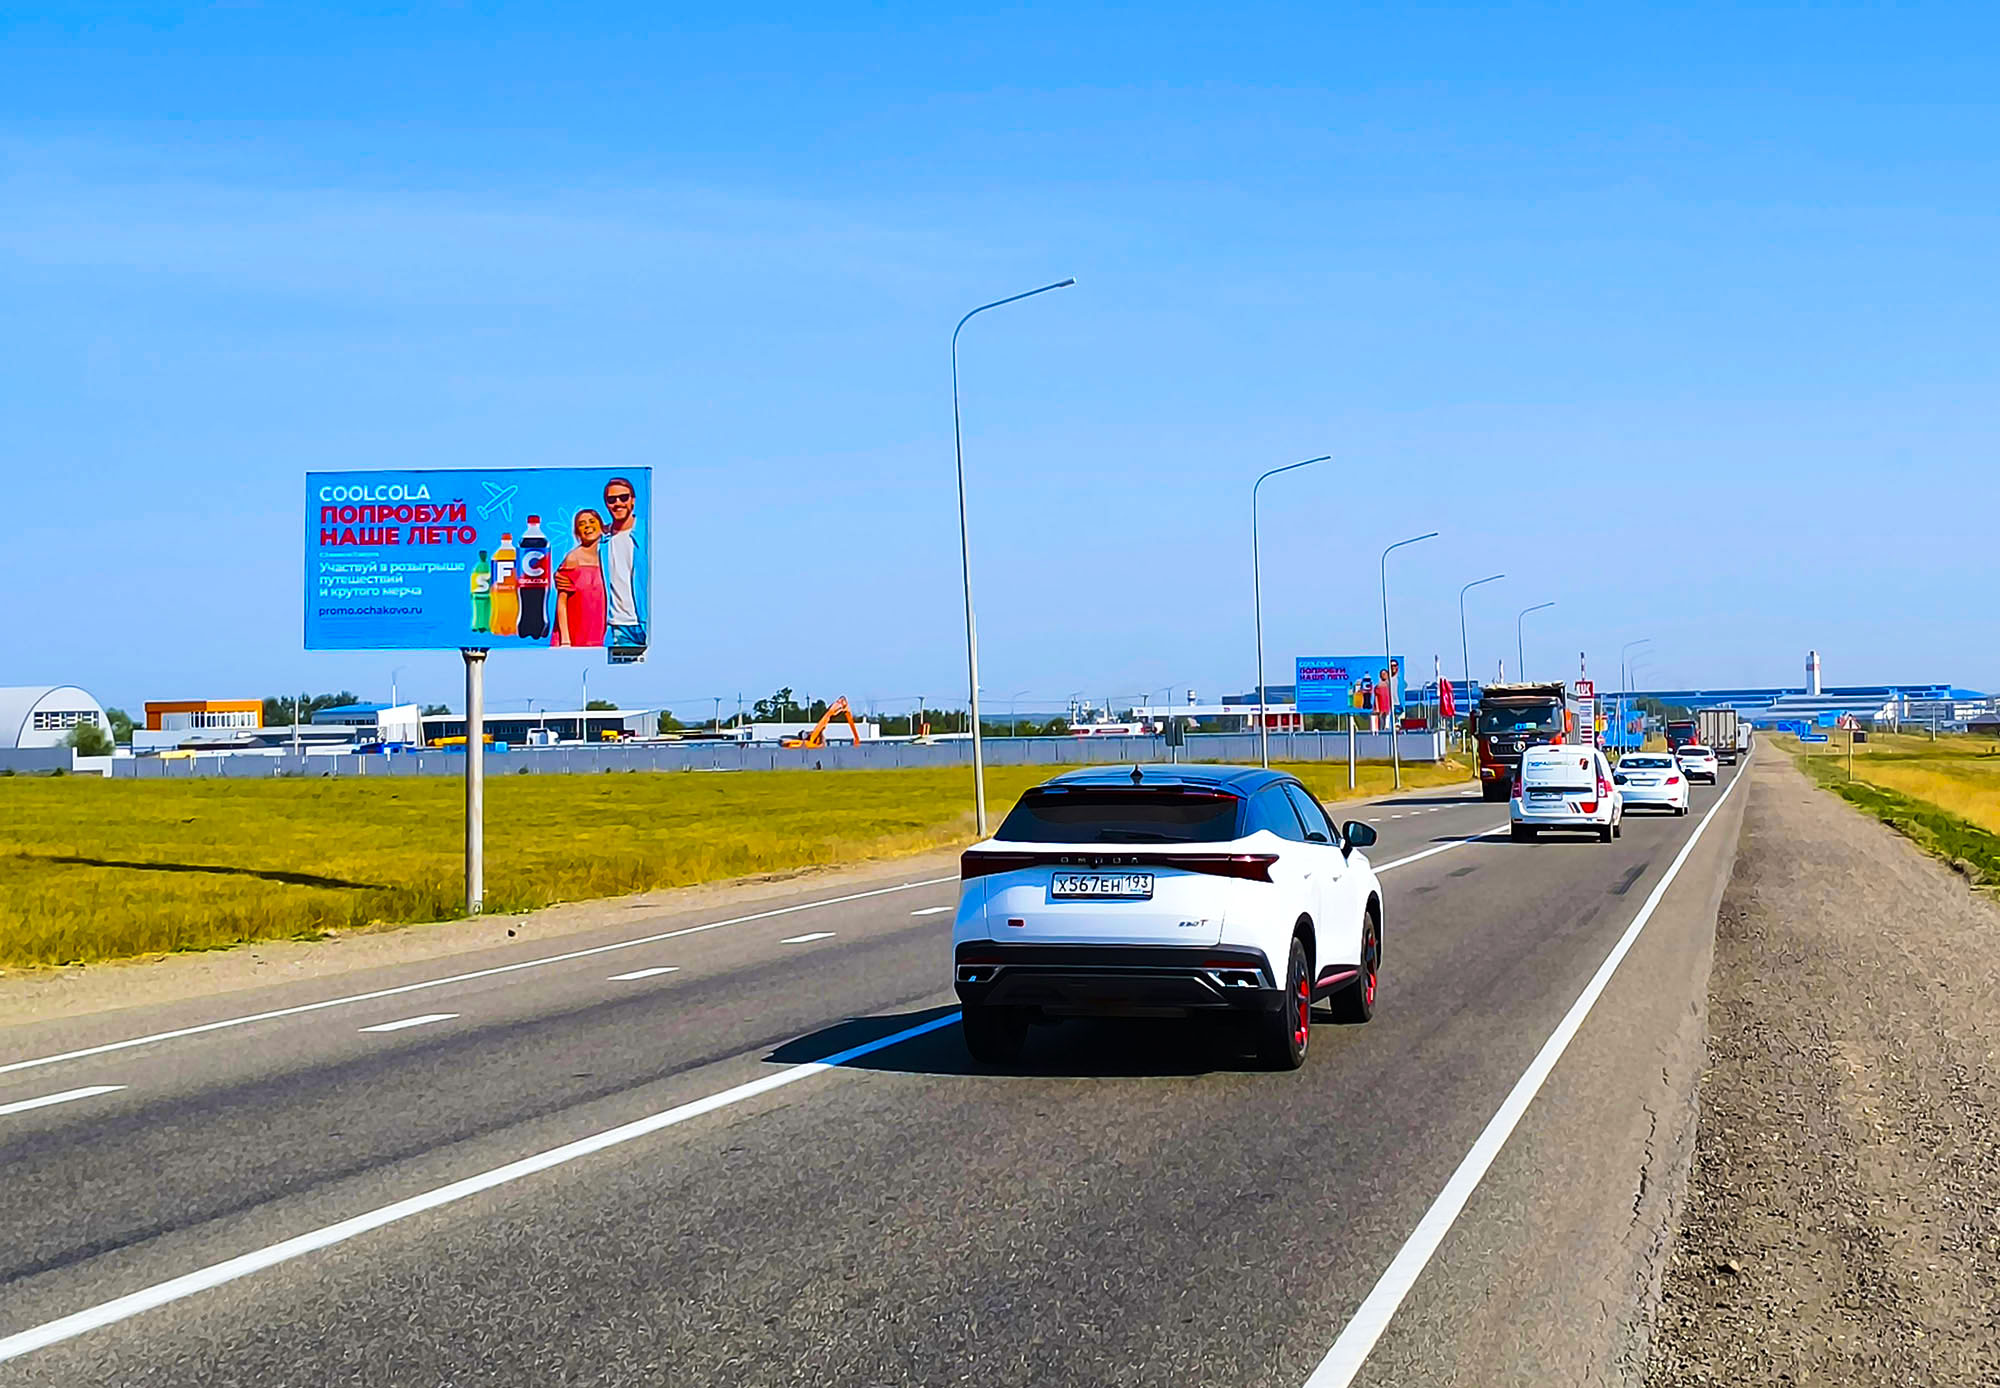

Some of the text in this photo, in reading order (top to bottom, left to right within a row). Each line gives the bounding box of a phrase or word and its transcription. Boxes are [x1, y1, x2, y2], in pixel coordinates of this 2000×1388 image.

[319, 484, 431, 502] COOLCOLA
[320, 498, 467, 524] ПОПРОБУЙ
[320, 526, 477, 546] НАШЕ ЛЕТО
[319, 561, 465, 575] Участвуй в розыгрыше
[497, 561, 515, 584] F
[522, 551, 545, 577] C
[319, 573, 403, 587] путешествий
[319, 587, 423, 599] и крутого мерча
[318, 606, 423, 616] promo.ochakovo.ru
